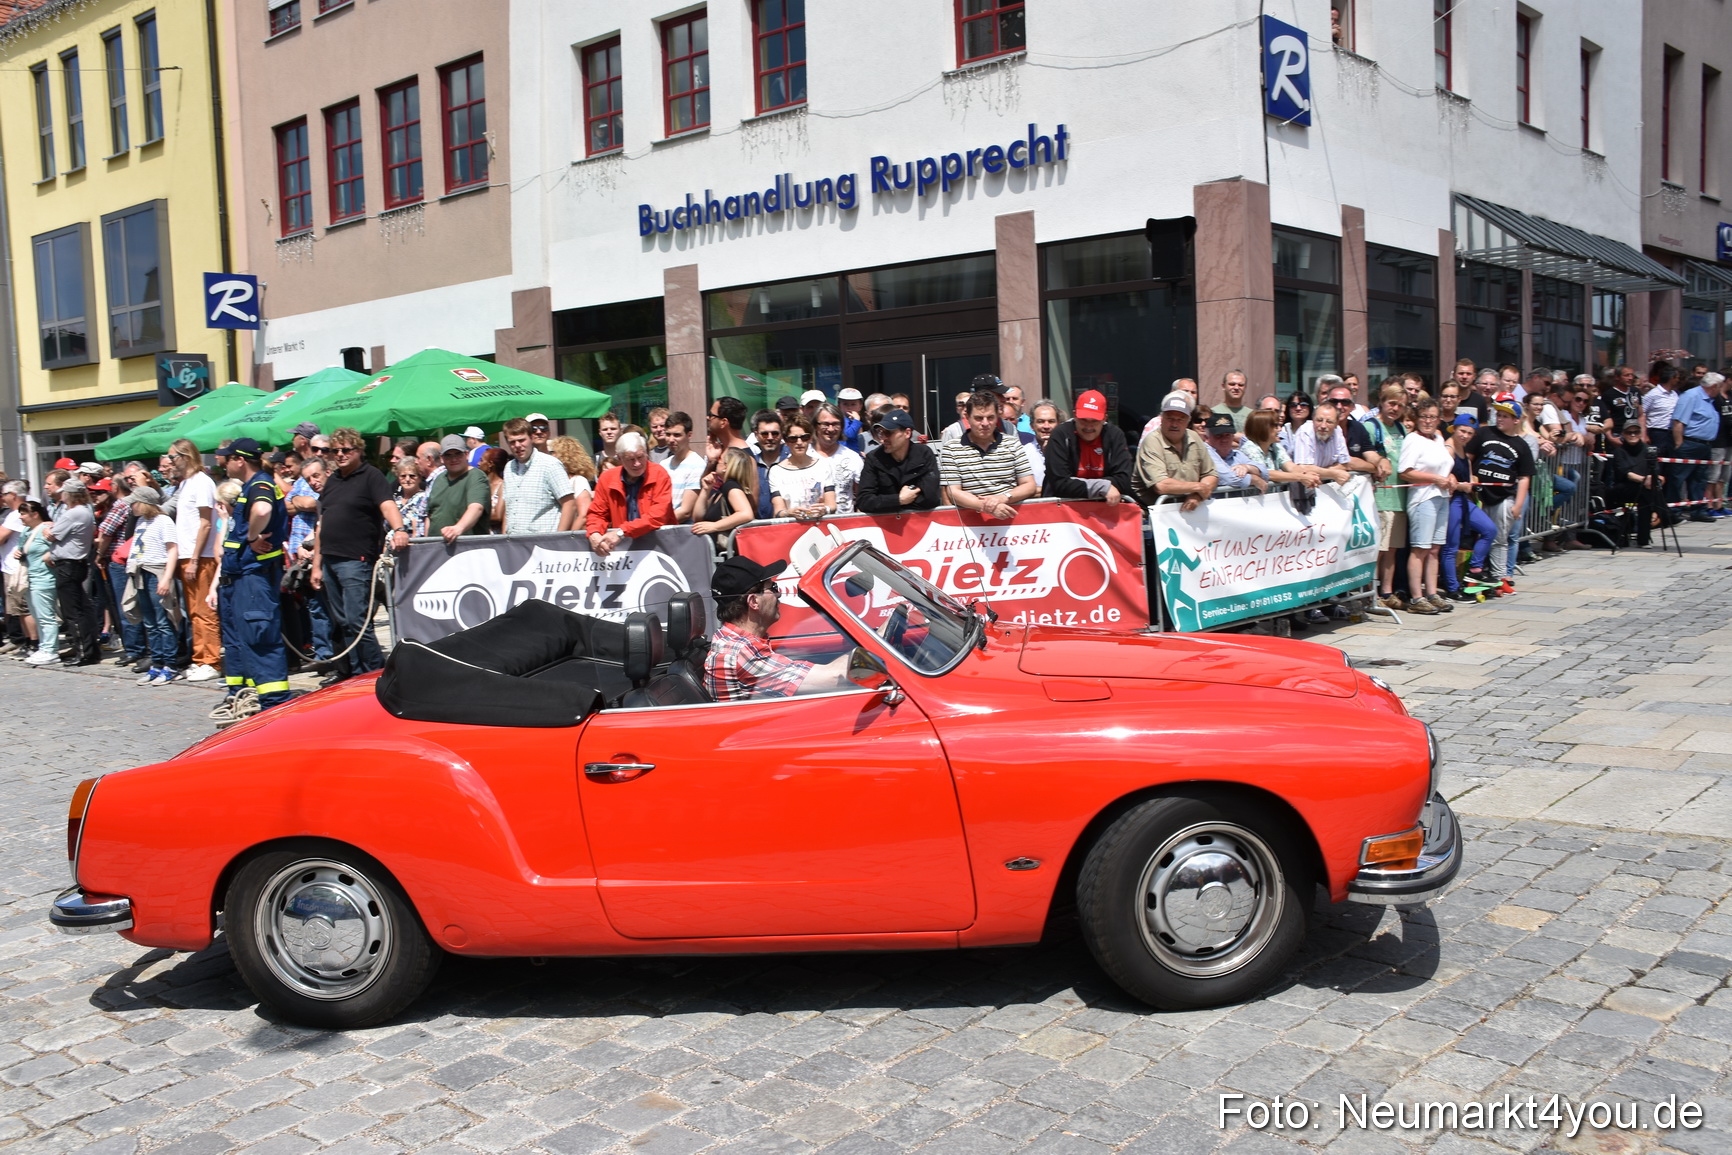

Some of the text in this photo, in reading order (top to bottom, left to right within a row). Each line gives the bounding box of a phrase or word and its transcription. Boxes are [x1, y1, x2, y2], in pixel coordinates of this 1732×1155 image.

[637, 122, 1069, 237] Buchhandlung Rupprecht
[448, 388, 544, 400] Lammsbräu
[455, 383, 522, 392] Neumarkter
[926, 528, 1051, 553] Autoklassik
[1224, 533, 1264, 560] UNS
[532, 555, 634, 575] Autoklassik
[902, 551, 1046, 590] Dietz
[1271, 545, 1339, 575] BESSER
[506, 575, 628, 610] Dietz
[1201, 603, 1248, 619] Service-Line:
